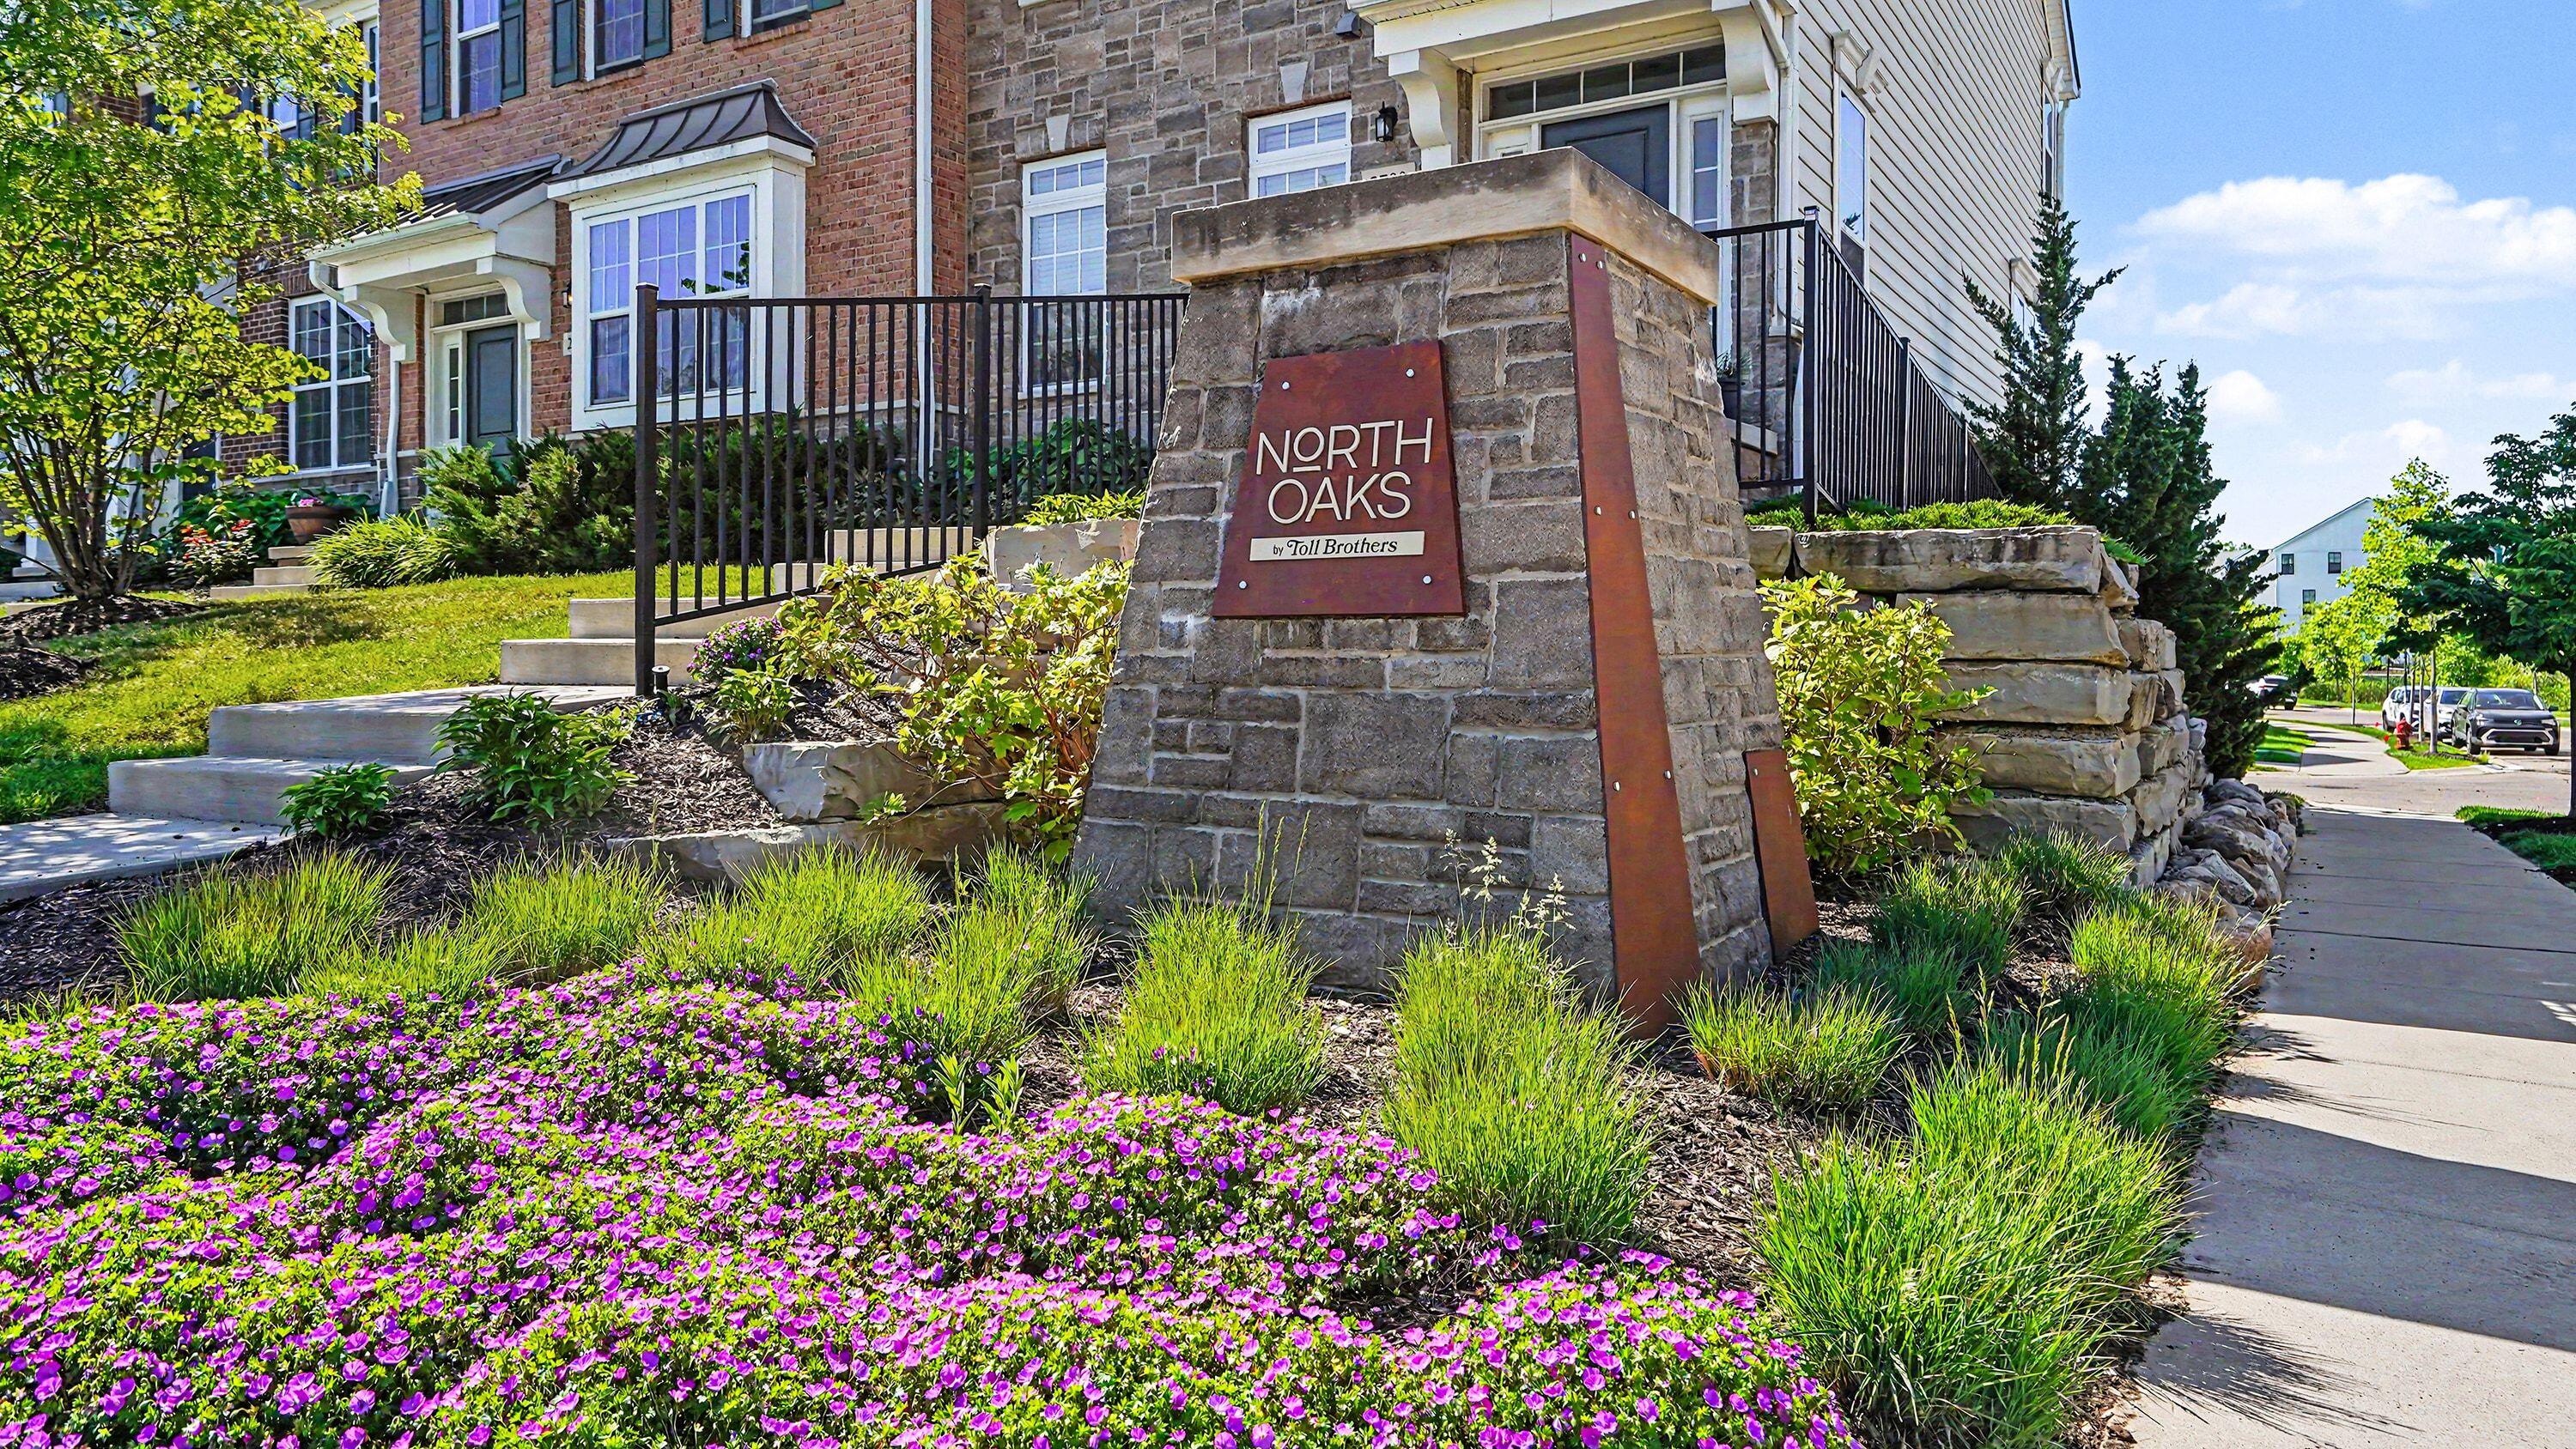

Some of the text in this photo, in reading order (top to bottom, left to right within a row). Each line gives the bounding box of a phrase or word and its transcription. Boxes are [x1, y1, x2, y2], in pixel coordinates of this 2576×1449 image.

[1255, 417, 1433, 475] NORTH
[1267, 471, 1411, 524] OAKS
[1273, 537, 1398, 556] by Toll Brothers
